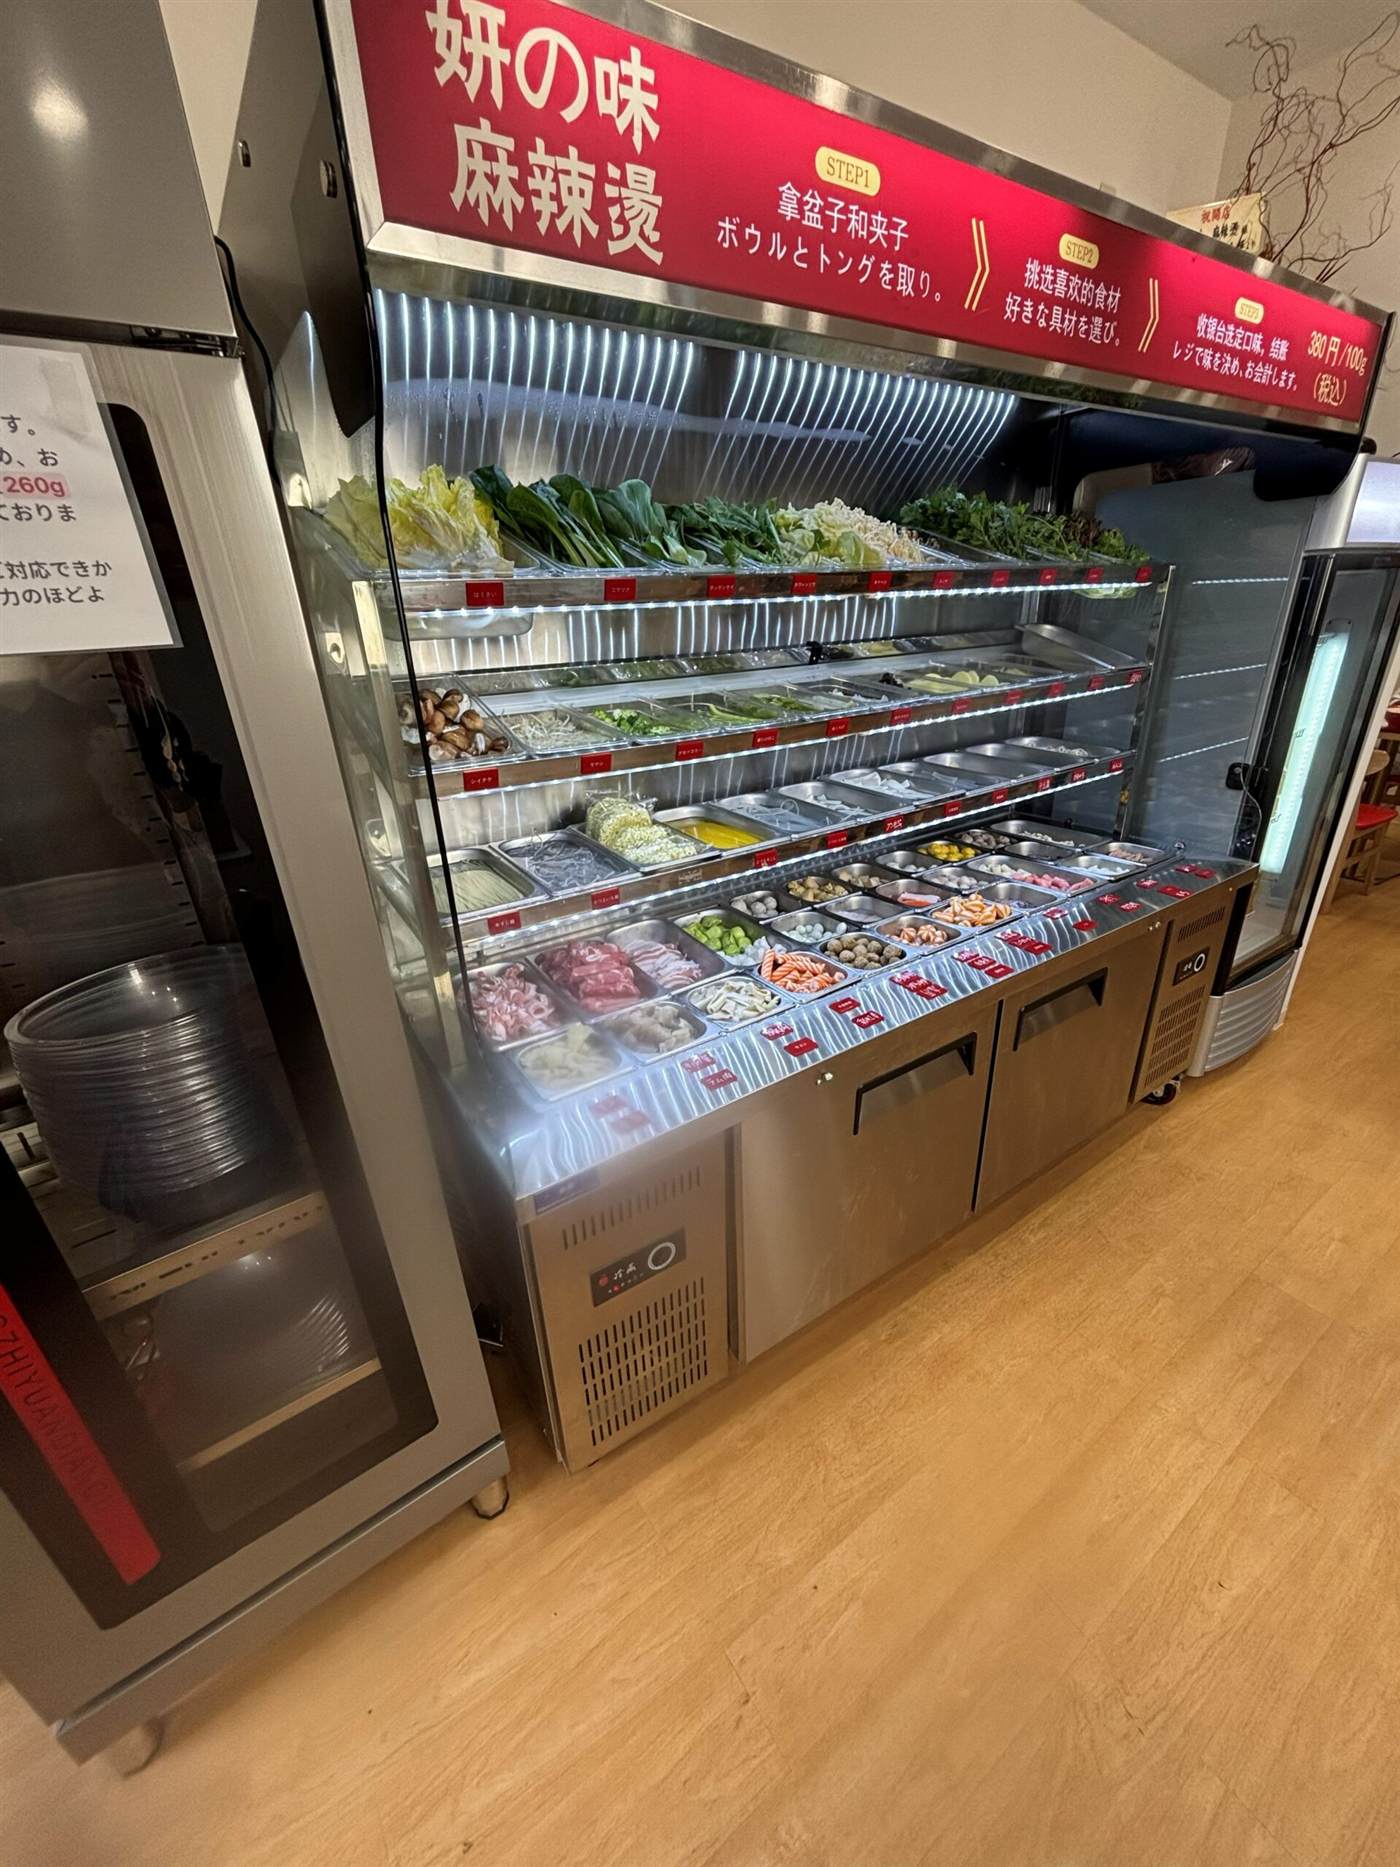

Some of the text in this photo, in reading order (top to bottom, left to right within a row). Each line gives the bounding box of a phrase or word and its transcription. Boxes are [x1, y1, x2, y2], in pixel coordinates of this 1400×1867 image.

[425, 0, 660, 154] 妍の味
[450, 117, 663, 266] 麻辣燙
[826, 156, 870, 188] STEP1
[777, 181, 910, 252] 拿盆子和夹子
[717, 216, 941, 302] ボウルとトングを取り。
[1065, 240, 1094, 264] STEP2
[1024, 257, 1121, 314] 挑选喜欢的食材
[1003, 291, 1120, 347] 好きな具材を選び。
[3, 476, 65, 497] 260g
[0, 560, 112, 579] 対応できか
[0, 585, 105, 606] 力のほどよ
